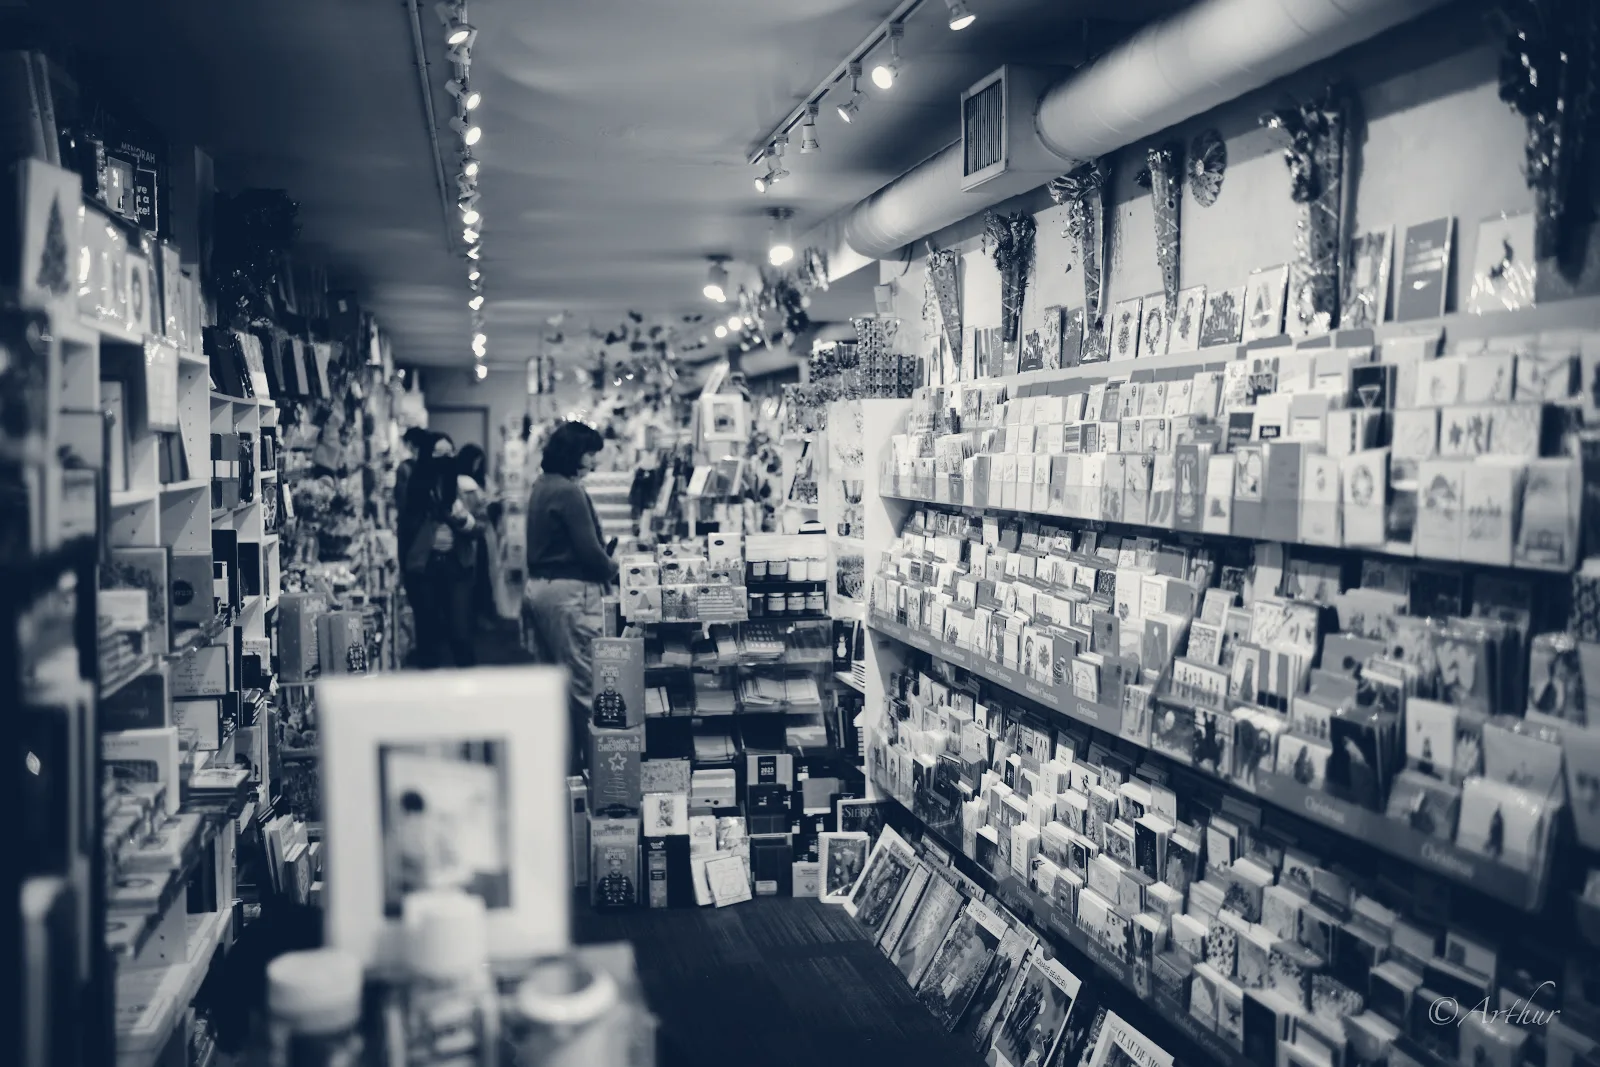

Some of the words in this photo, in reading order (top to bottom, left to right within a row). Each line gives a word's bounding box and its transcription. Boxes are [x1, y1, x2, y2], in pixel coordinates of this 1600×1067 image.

[121, 142, 156, 164] MENORAH
[1076, 702, 1099, 720] Christmas
[597, 743, 627, 752] CHRISTMAS
[1304, 796, 1345, 824] Christmas
[1421, 843, 1474, 879] Christmas
[1016, 885, 1034, 906] Christmas
[1050, 912, 1071, 935] Christmas
[1117, 1029, 1147, 1061] CLAUDE
